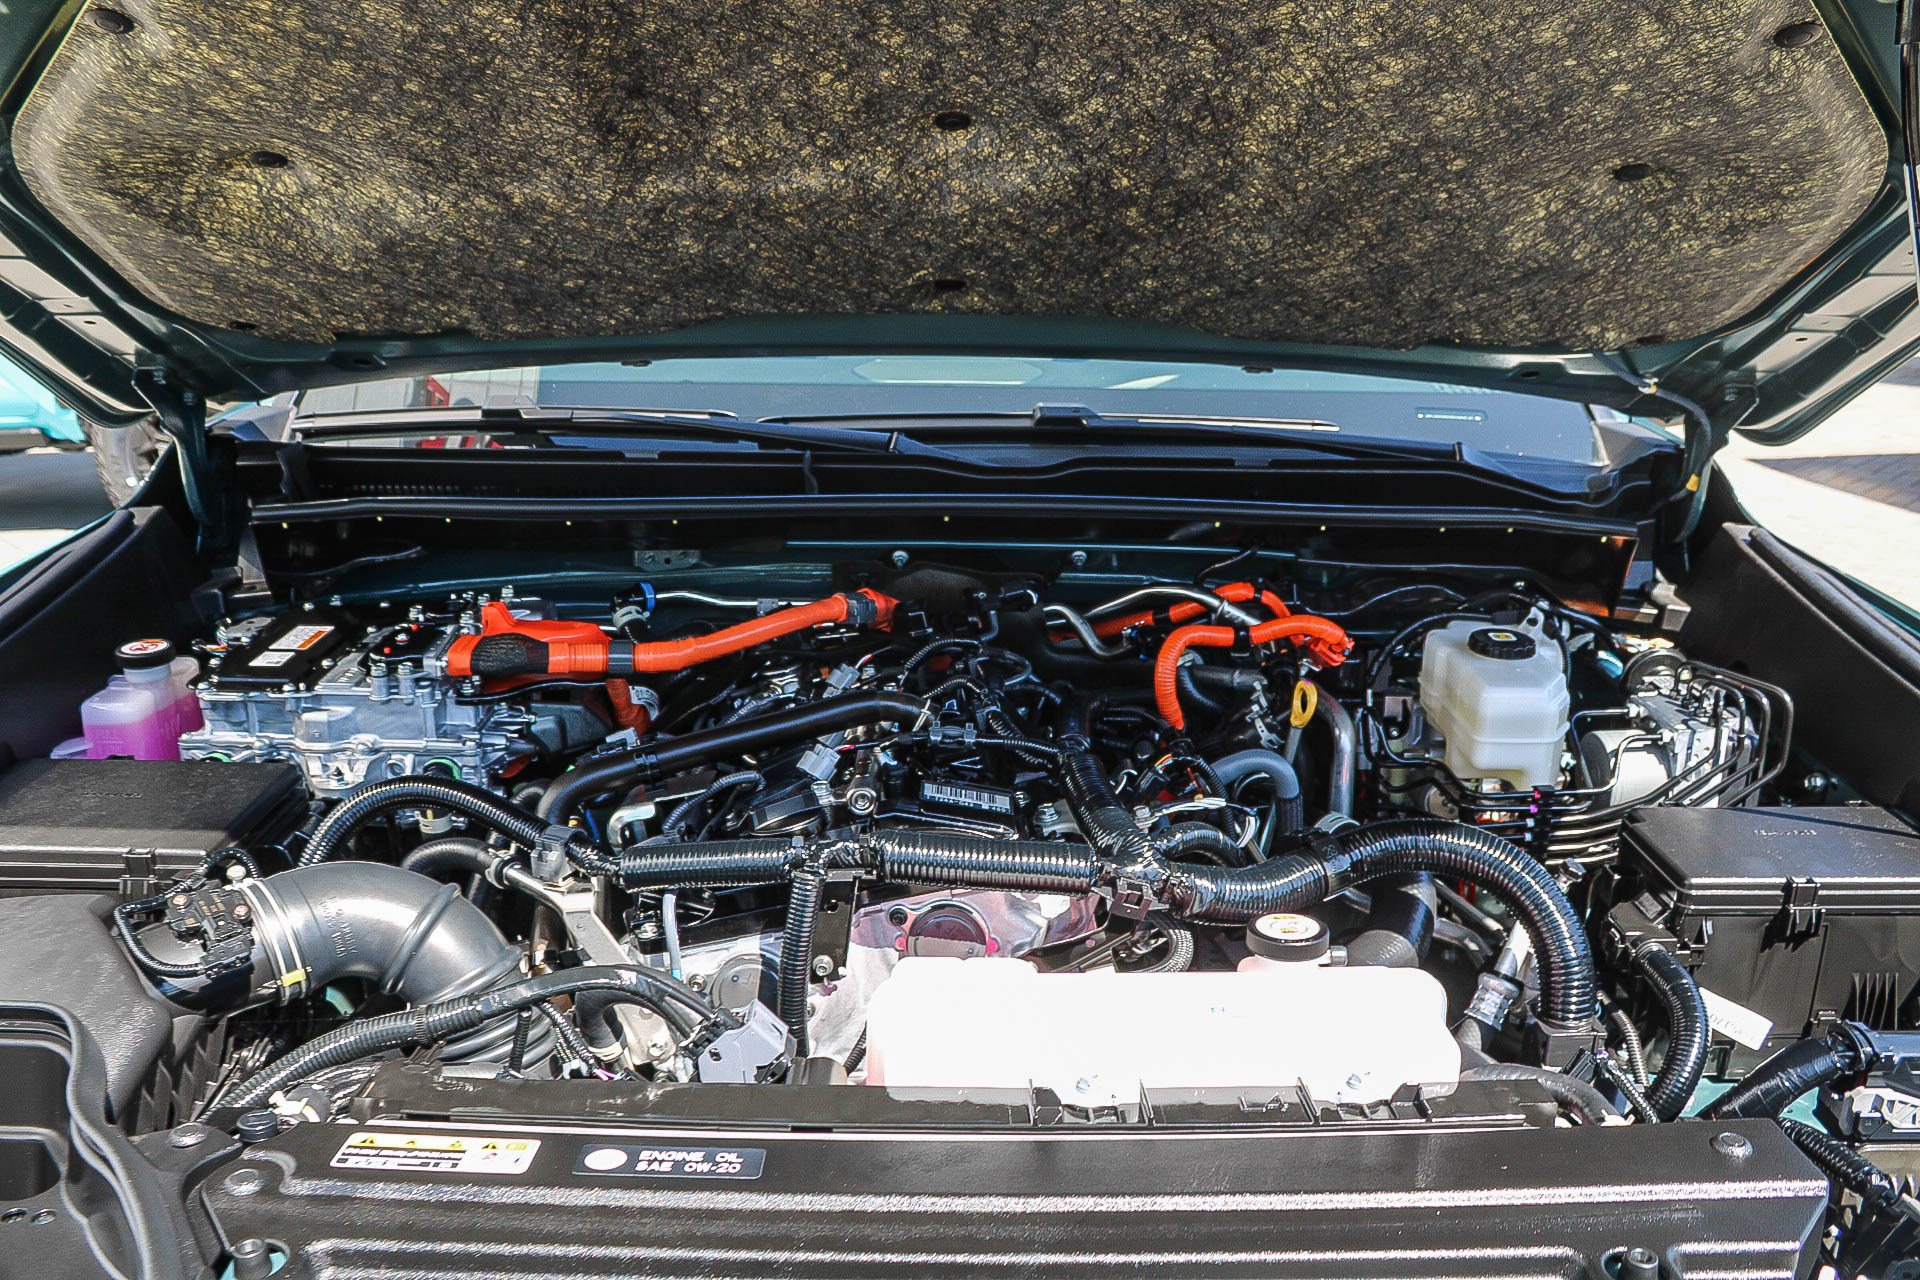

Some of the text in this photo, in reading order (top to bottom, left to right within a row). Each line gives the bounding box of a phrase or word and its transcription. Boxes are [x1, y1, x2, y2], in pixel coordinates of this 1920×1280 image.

[638, 1150, 744, 1163] ENGINE OIL
[635, 1161, 742, 1173] SAE 0W-20
